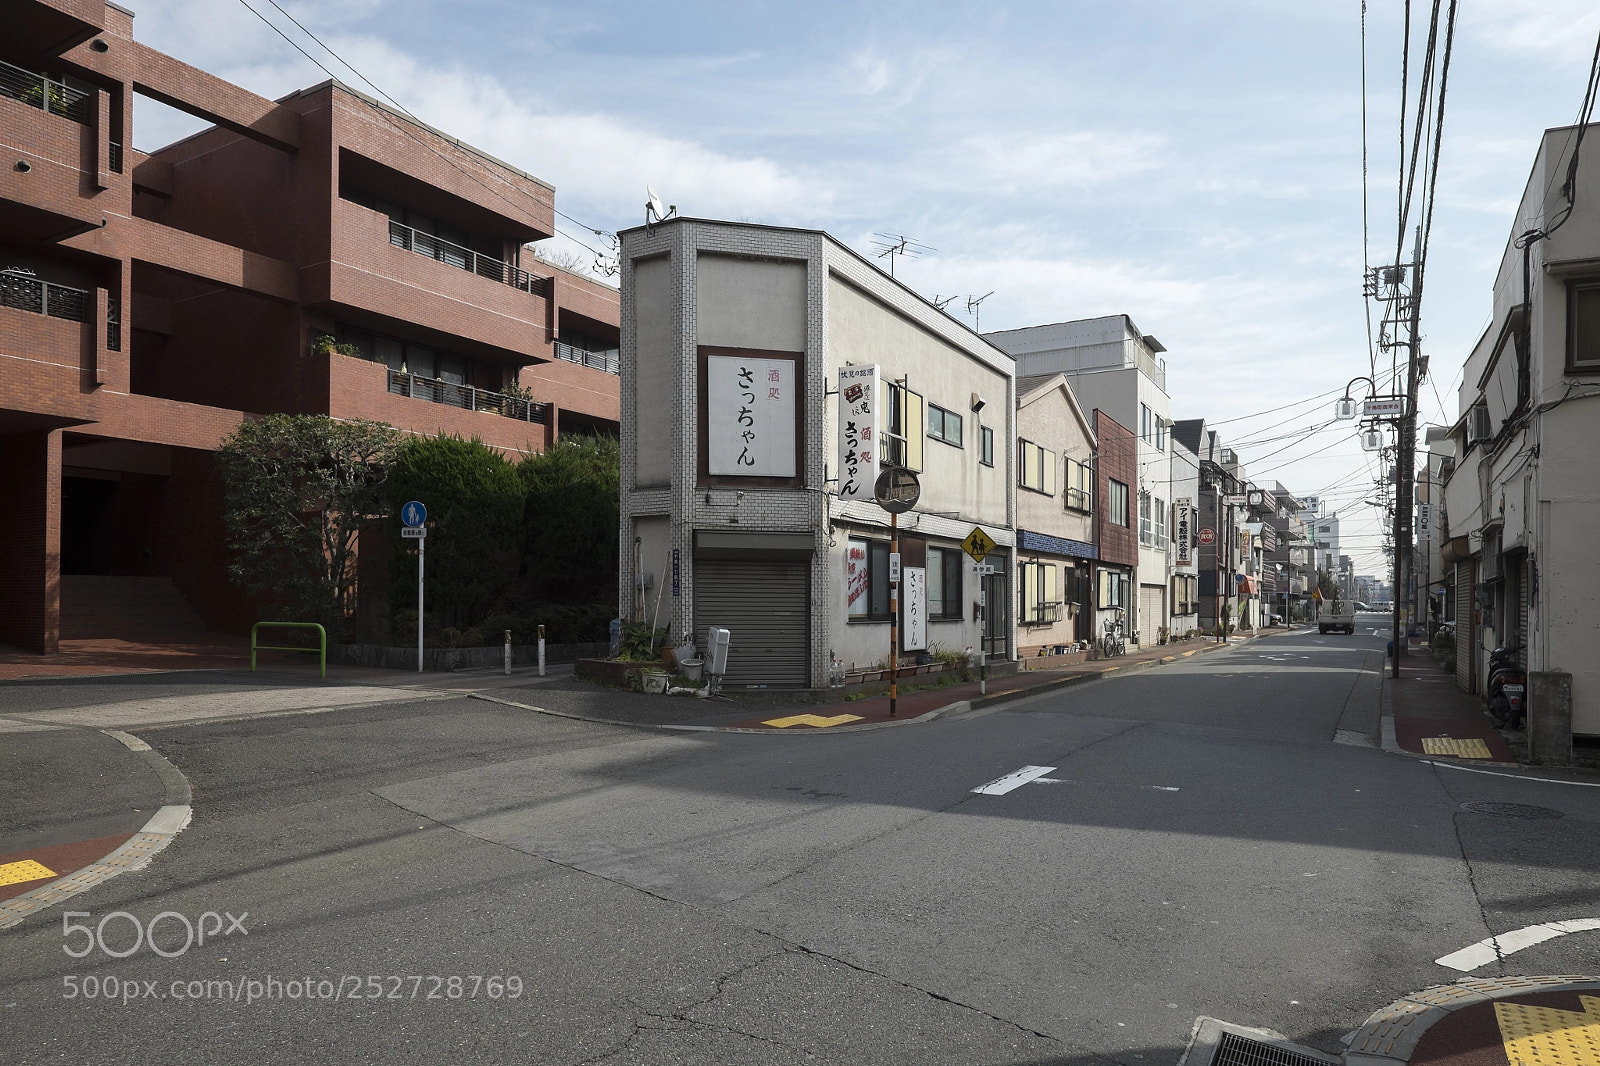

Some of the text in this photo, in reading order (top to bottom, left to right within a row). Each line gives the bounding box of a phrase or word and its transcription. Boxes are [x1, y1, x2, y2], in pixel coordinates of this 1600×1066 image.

[737, 366, 755, 466] さっちゃん
[768, 369, 780, 399] 酒処
[841, 421, 861, 496] さっちゃん
[860, 427, 872, 463] 酒処
[1179, 507, 1188, 560] アイ電設株式会社
[910, 571, 918, 646] さっちゃん
